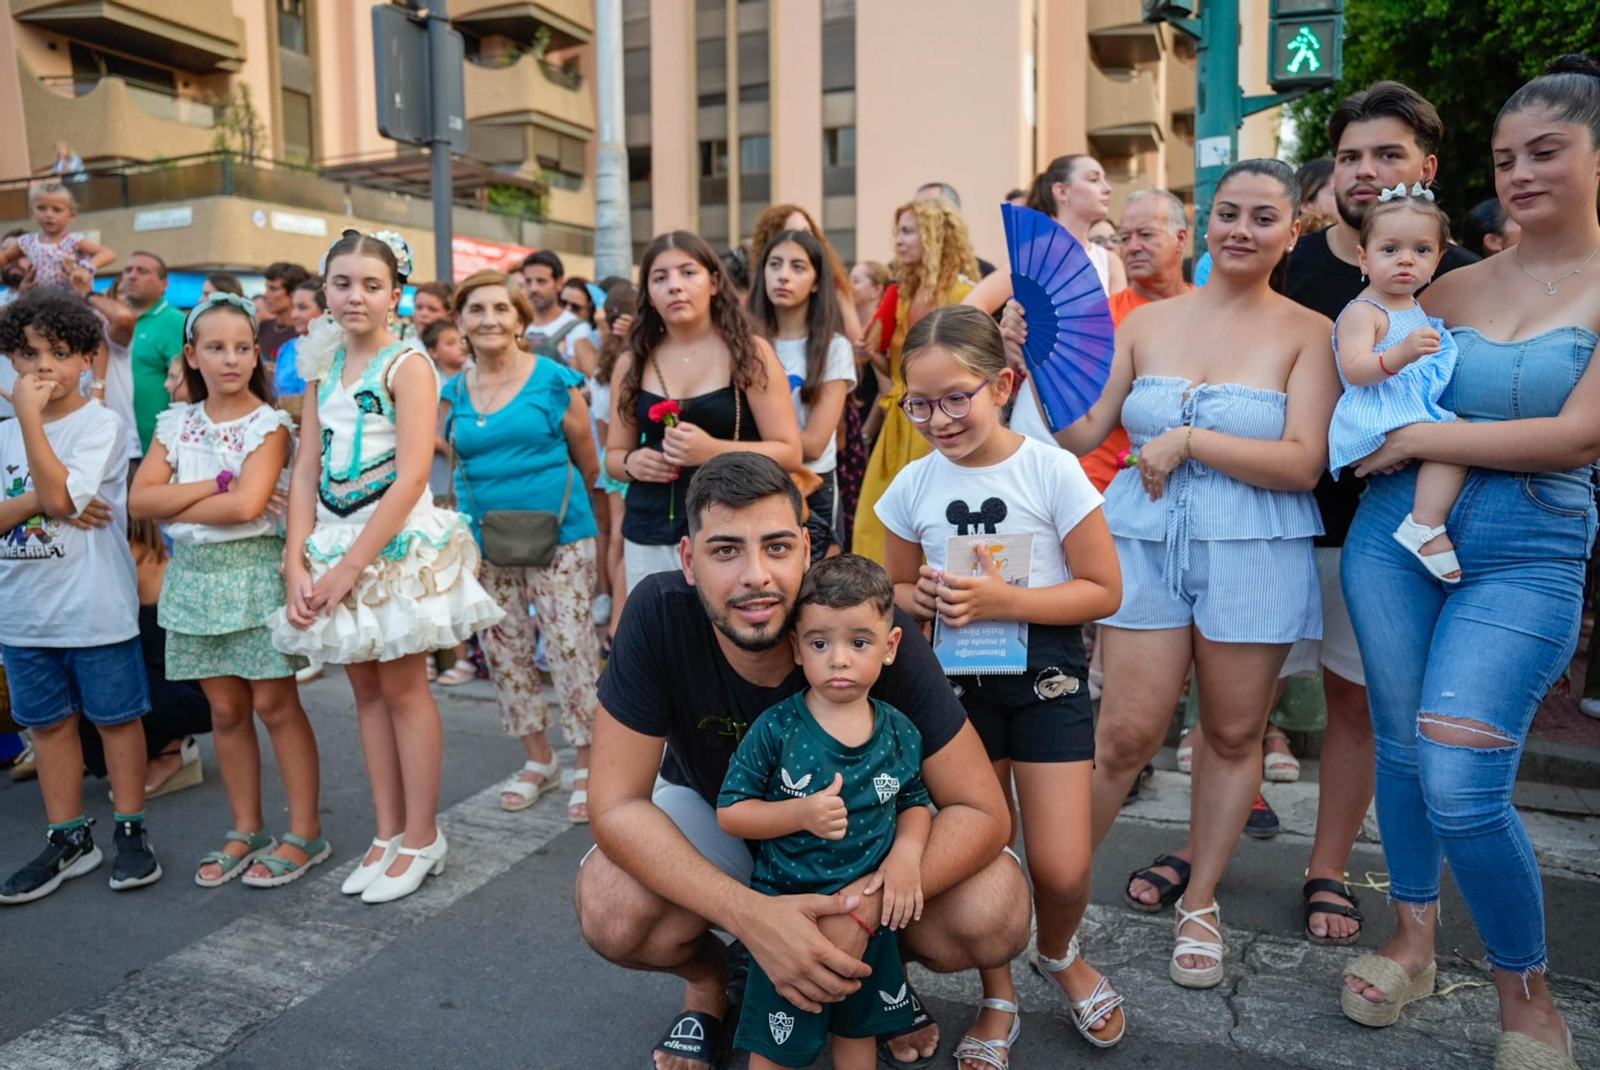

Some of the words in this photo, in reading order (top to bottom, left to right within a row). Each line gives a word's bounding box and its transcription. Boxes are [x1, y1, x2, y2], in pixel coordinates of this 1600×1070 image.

[959, 628, 980, 636] Pérez
[981, 627, 1005, 636] Ratón
[955, 649, 1006, 658] Bienvenid@s
[663, 1040, 702, 1053] ellesse
